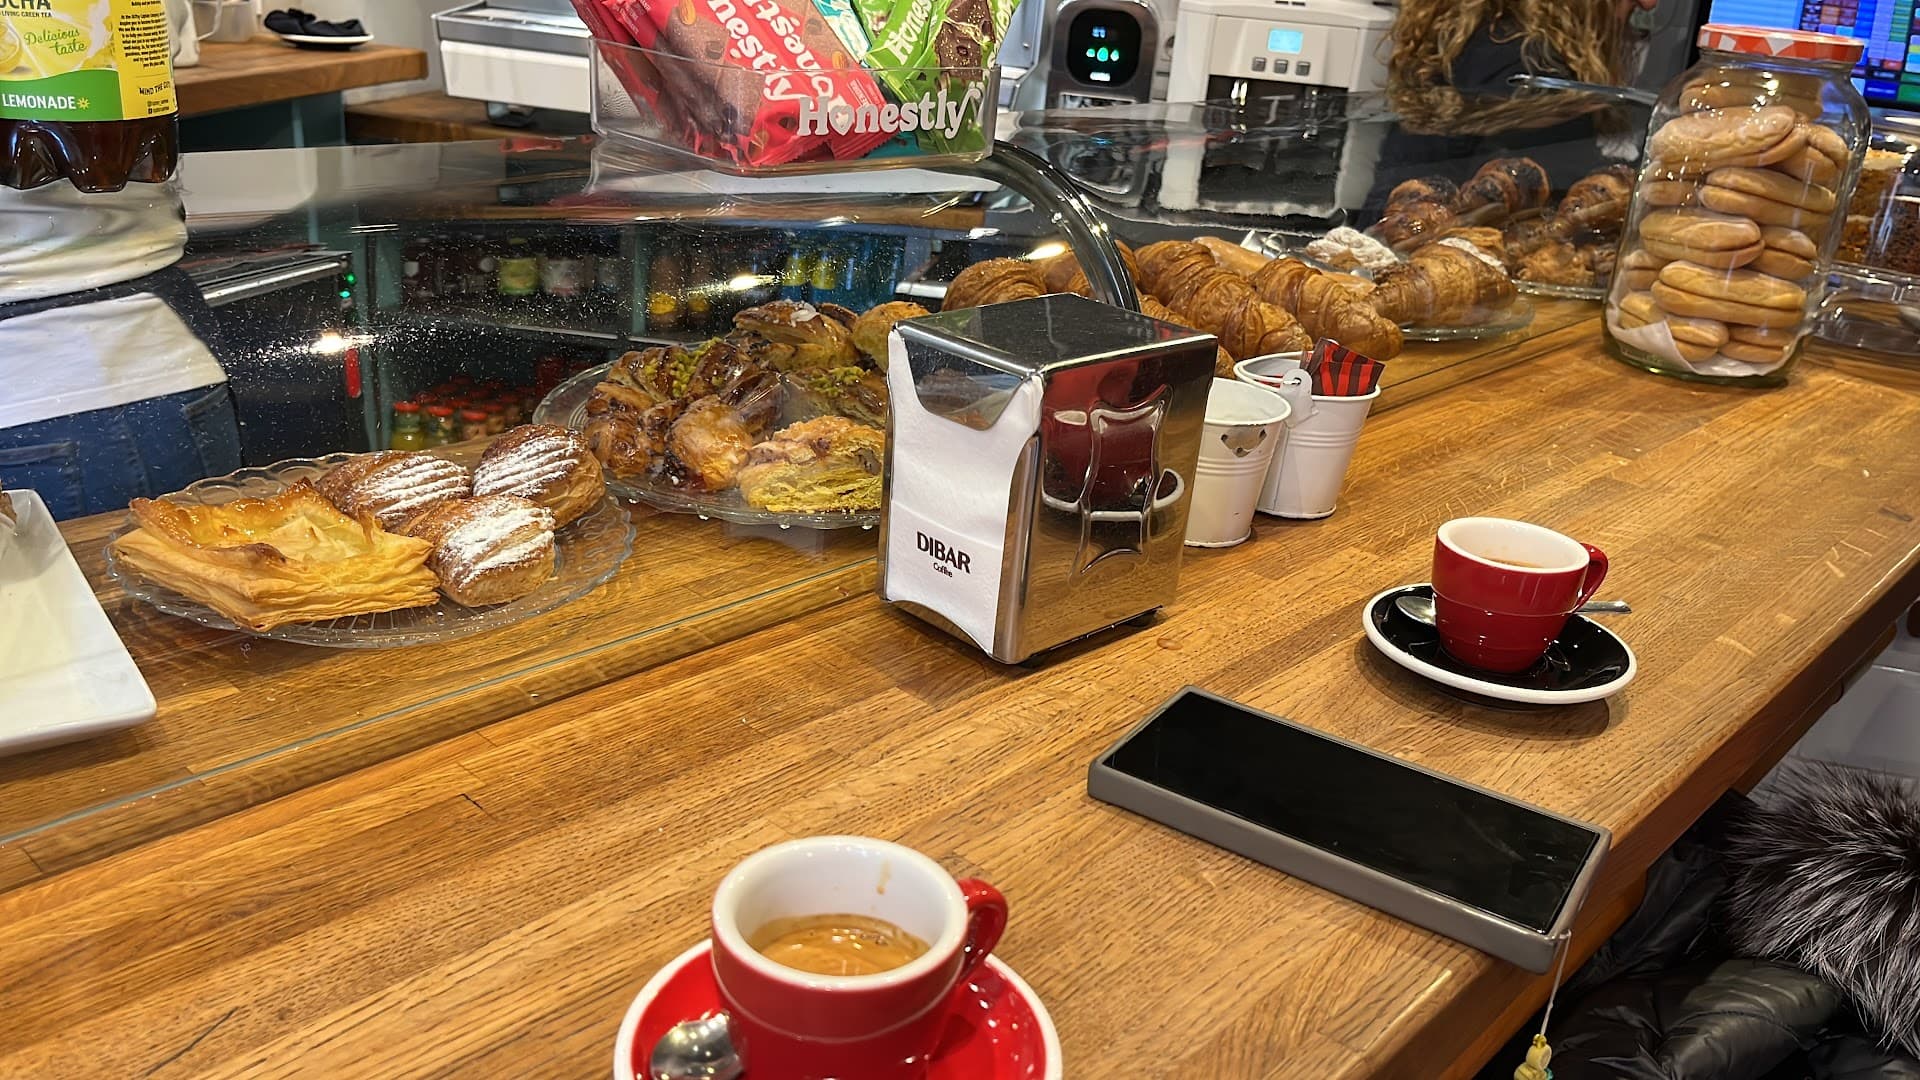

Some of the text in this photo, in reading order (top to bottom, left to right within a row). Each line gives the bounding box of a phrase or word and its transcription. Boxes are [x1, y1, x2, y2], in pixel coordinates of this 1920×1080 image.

[24, 29, 80, 45] Delicious
[49, 39, 88, 56] taste
[139, 87, 154, 95] MIND
[154, 82, 163, 93] THE
[2, 93, 77, 109] LEMONADE
[796, 81, 984, 139] Honestly
[916, 531, 971, 574] DIBAR
[933, 562, 953, 578] Coffee
